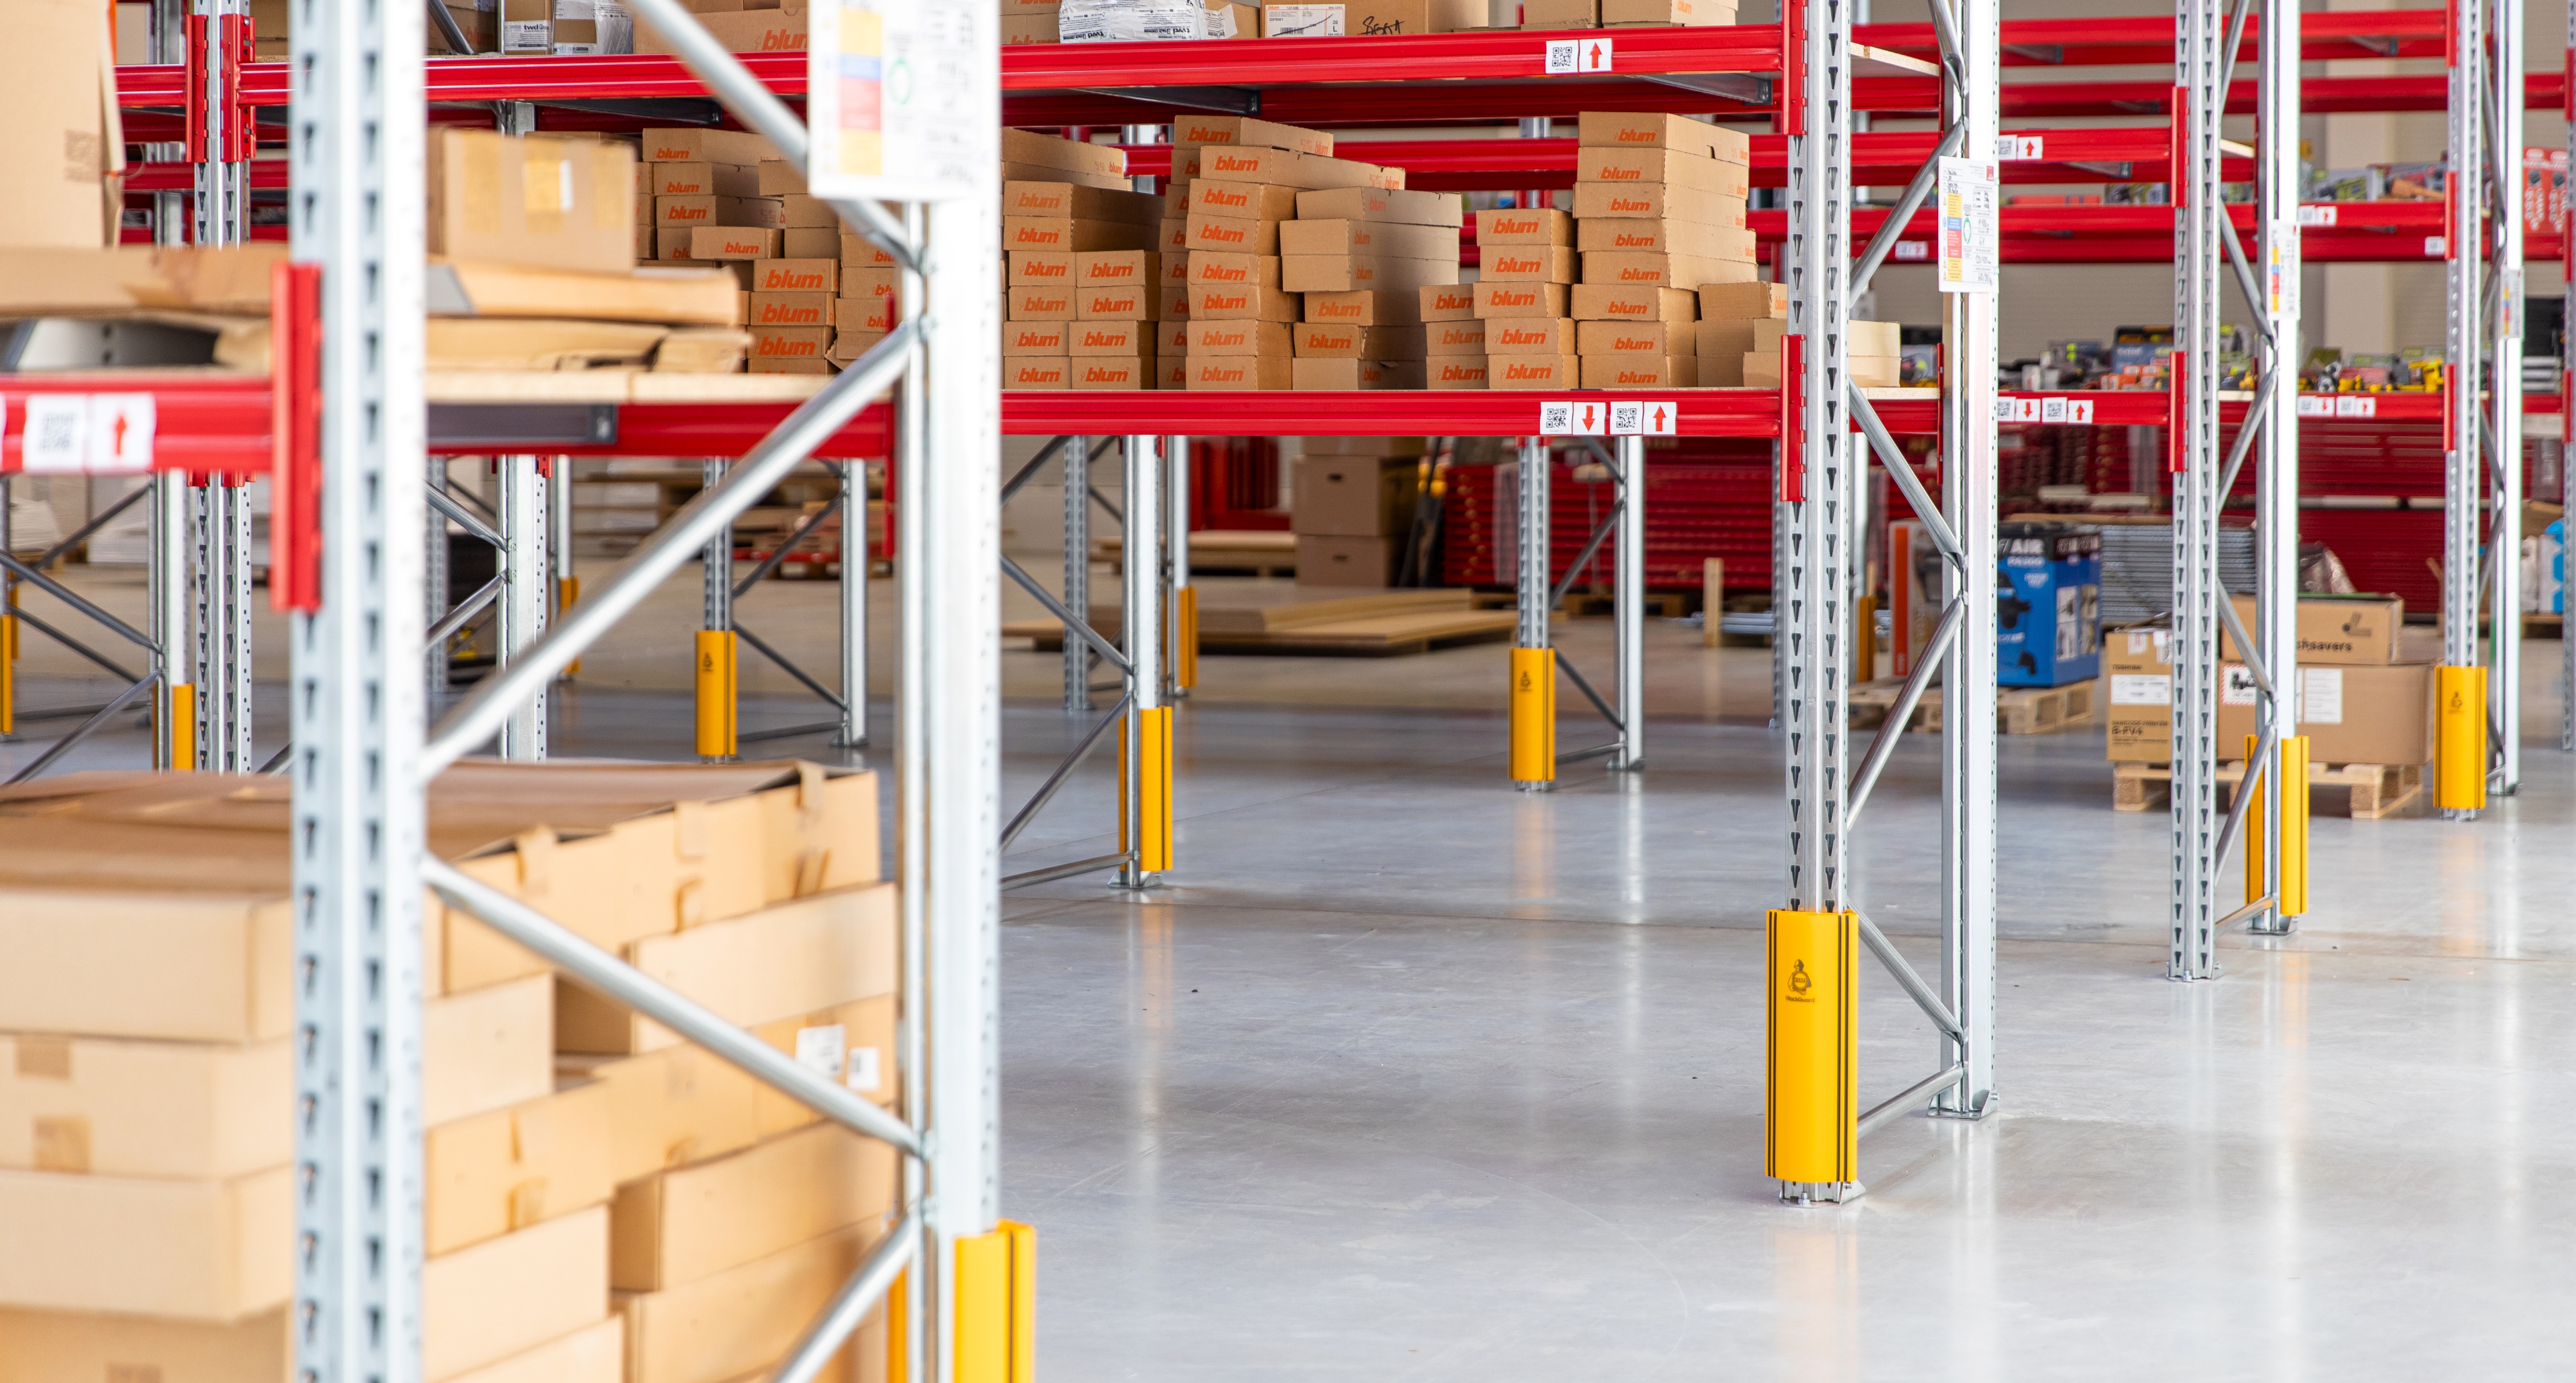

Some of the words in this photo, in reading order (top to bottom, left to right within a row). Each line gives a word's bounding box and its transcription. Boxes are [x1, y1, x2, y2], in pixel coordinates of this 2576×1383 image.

[1188, 127, 1231, 142] blum
[1618, 129, 1656, 141] blum
[656, 148, 689, 159] blum
[1315, 141, 1328, 156] blum
[1110, 162, 1122, 174] blum
[1215, 156, 1258, 171] blum
[1601, 167, 1640, 179] blum
[666, 182, 699, 193] blum
[1385, 176, 1399, 189] blum
[1737, 183, 1747, 195] blum
[1018, 193, 1060, 208] blum
[1204, 189, 1247, 206] blum
[1369, 197, 1385, 211] blum
[1610, 199, 1650, 211] blum
[668, 206, 707, 220] blum
[1735, 214, 1744, 226] blum
[1201, 225, 1244, 242] blum
[1494, 219, 1538, 234] blum
[1017, 228, 1059, 243] blum
[1354, 231, 1369, 244] blum
[1615, 234, 1654, 246] blum
[672, 248, 690, 258] blu
[724, 242, 759, 253] blum
[1745, 245, 1755, 256] blum
[875, 250, 894, 261] blu
[1025, 261, 1066, 276] blum
[1091, 263, 1133, 277] blum
[1496, 257, 1541, 272] blum
[766, 270, 823, 288] blum
[1203, 264, 1246, 281] blum
[1356, 265, 1372, 279] blum
[1621, 268, 1660, 280] blum
[1025, 297, 1066, 311] blum
[1092, 298, 1134, 313] blum
[1204, 295, 1246, 309] blum
[1491, 291, 1535, 306] blum
[762, 304, 818, 322] blum
[1318, 302, 1362, 317] blum
[1608, 302, 1647, 314] blum
[1018, 332, 1059, 346] blum
[1084, 332, 1126, 346] blum
[1202, 331, 1244, 346] blum
[1308, 334, 1351, 348] blum
[1442, 329, 1485, 344] blum
[1501, 329, 1546, 344] blum
[758, 336, 815, 355] blum
[1614, 338, 1654, 350] blum
[1019, 368, 1060, 382] blum
[1086, 368, 1128, 382] blum
[1201, 367, 1243, 381] blum
[1363, 367, 1379, 381] blum
[1441, 365, 1485, 381] blum
[1506, 364, 1551, 379] blum
[1618, 372, 1657, 383] blum
